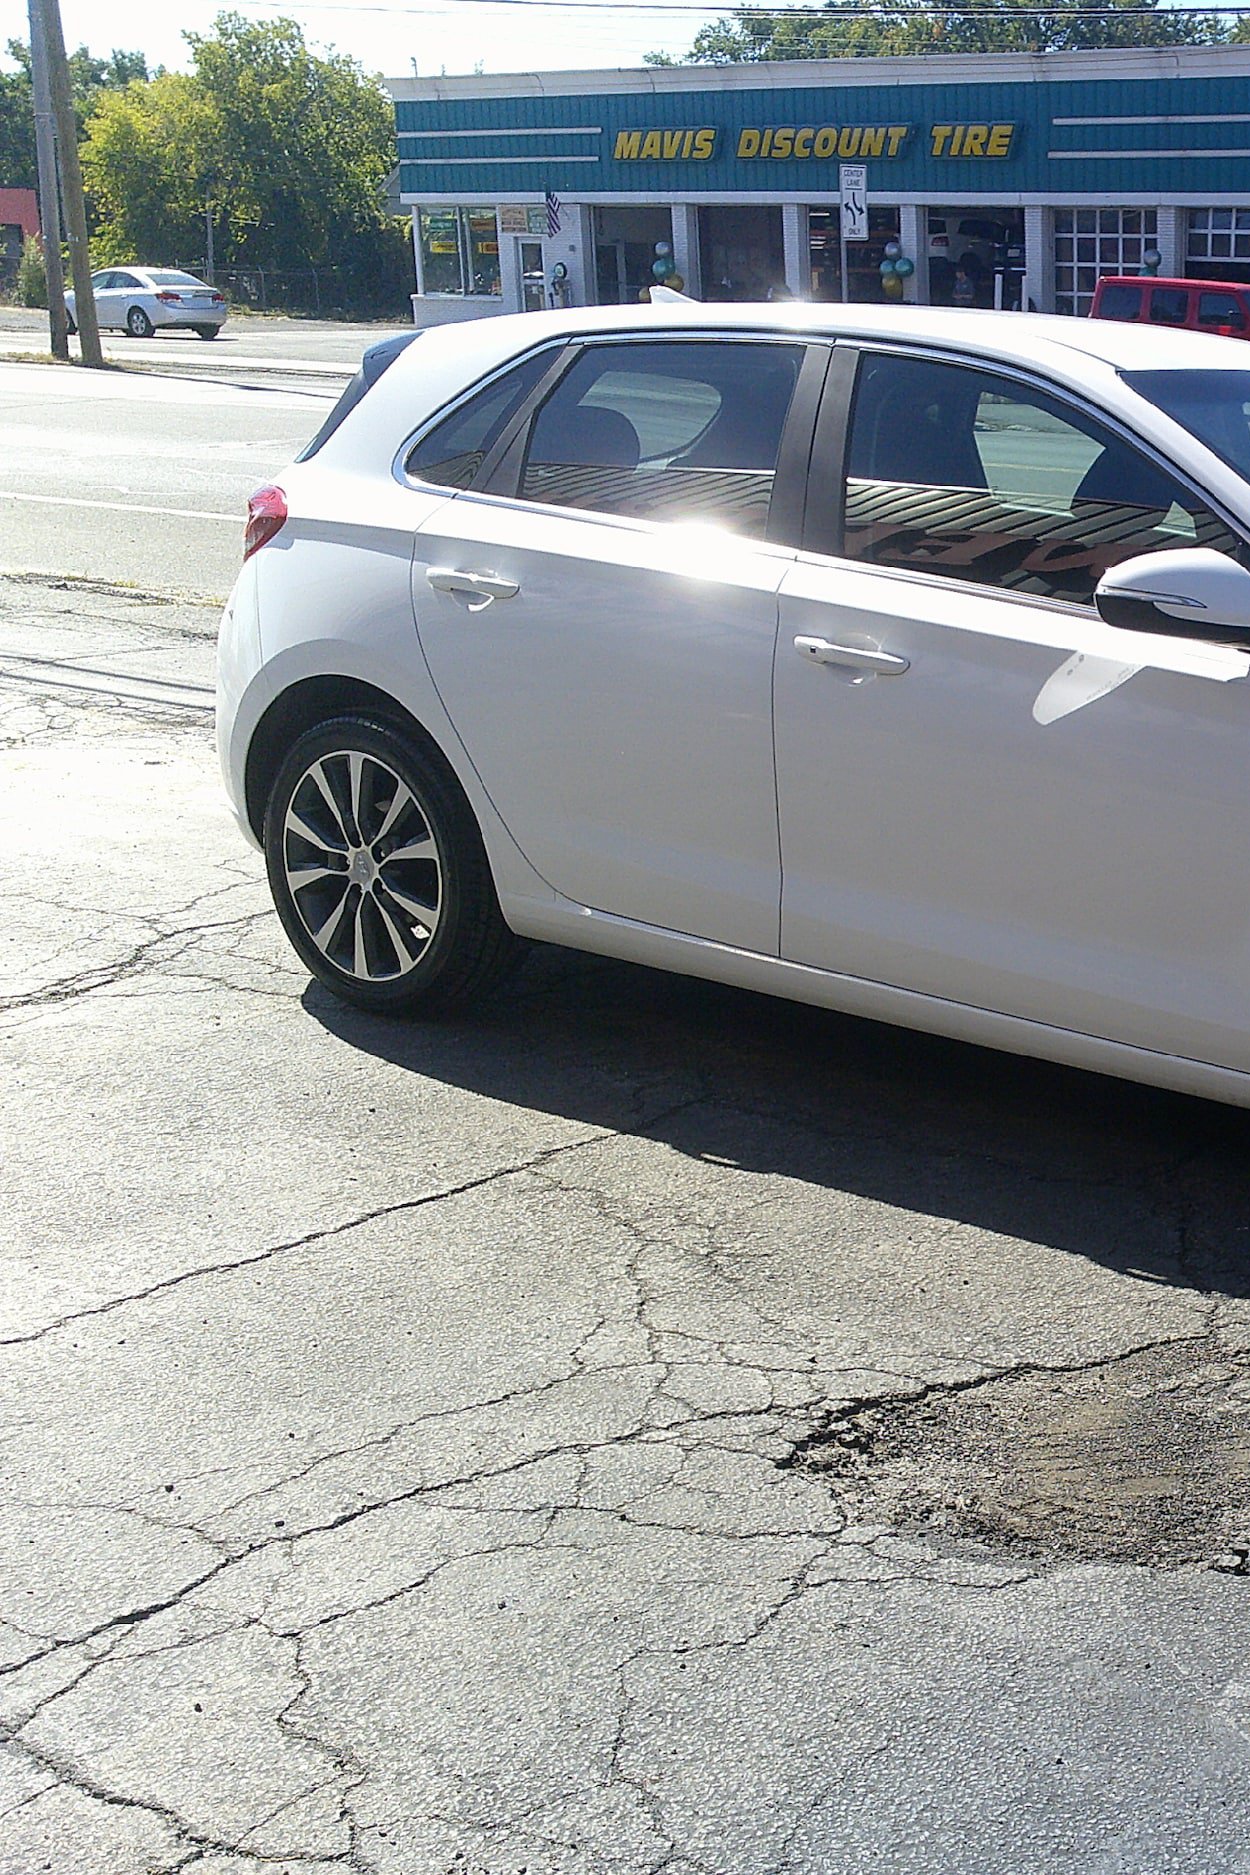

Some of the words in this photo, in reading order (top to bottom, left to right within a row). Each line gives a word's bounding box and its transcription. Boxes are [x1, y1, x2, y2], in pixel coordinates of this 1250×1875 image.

[613, 129, 716, 160] MAVIS
[736, 125, 908, 159] DISCOUNT
[931, 124, 1014, 157] TIRE
[843, 169, 863, 177] CENTER
[846, 179, 861, 187] LANE
